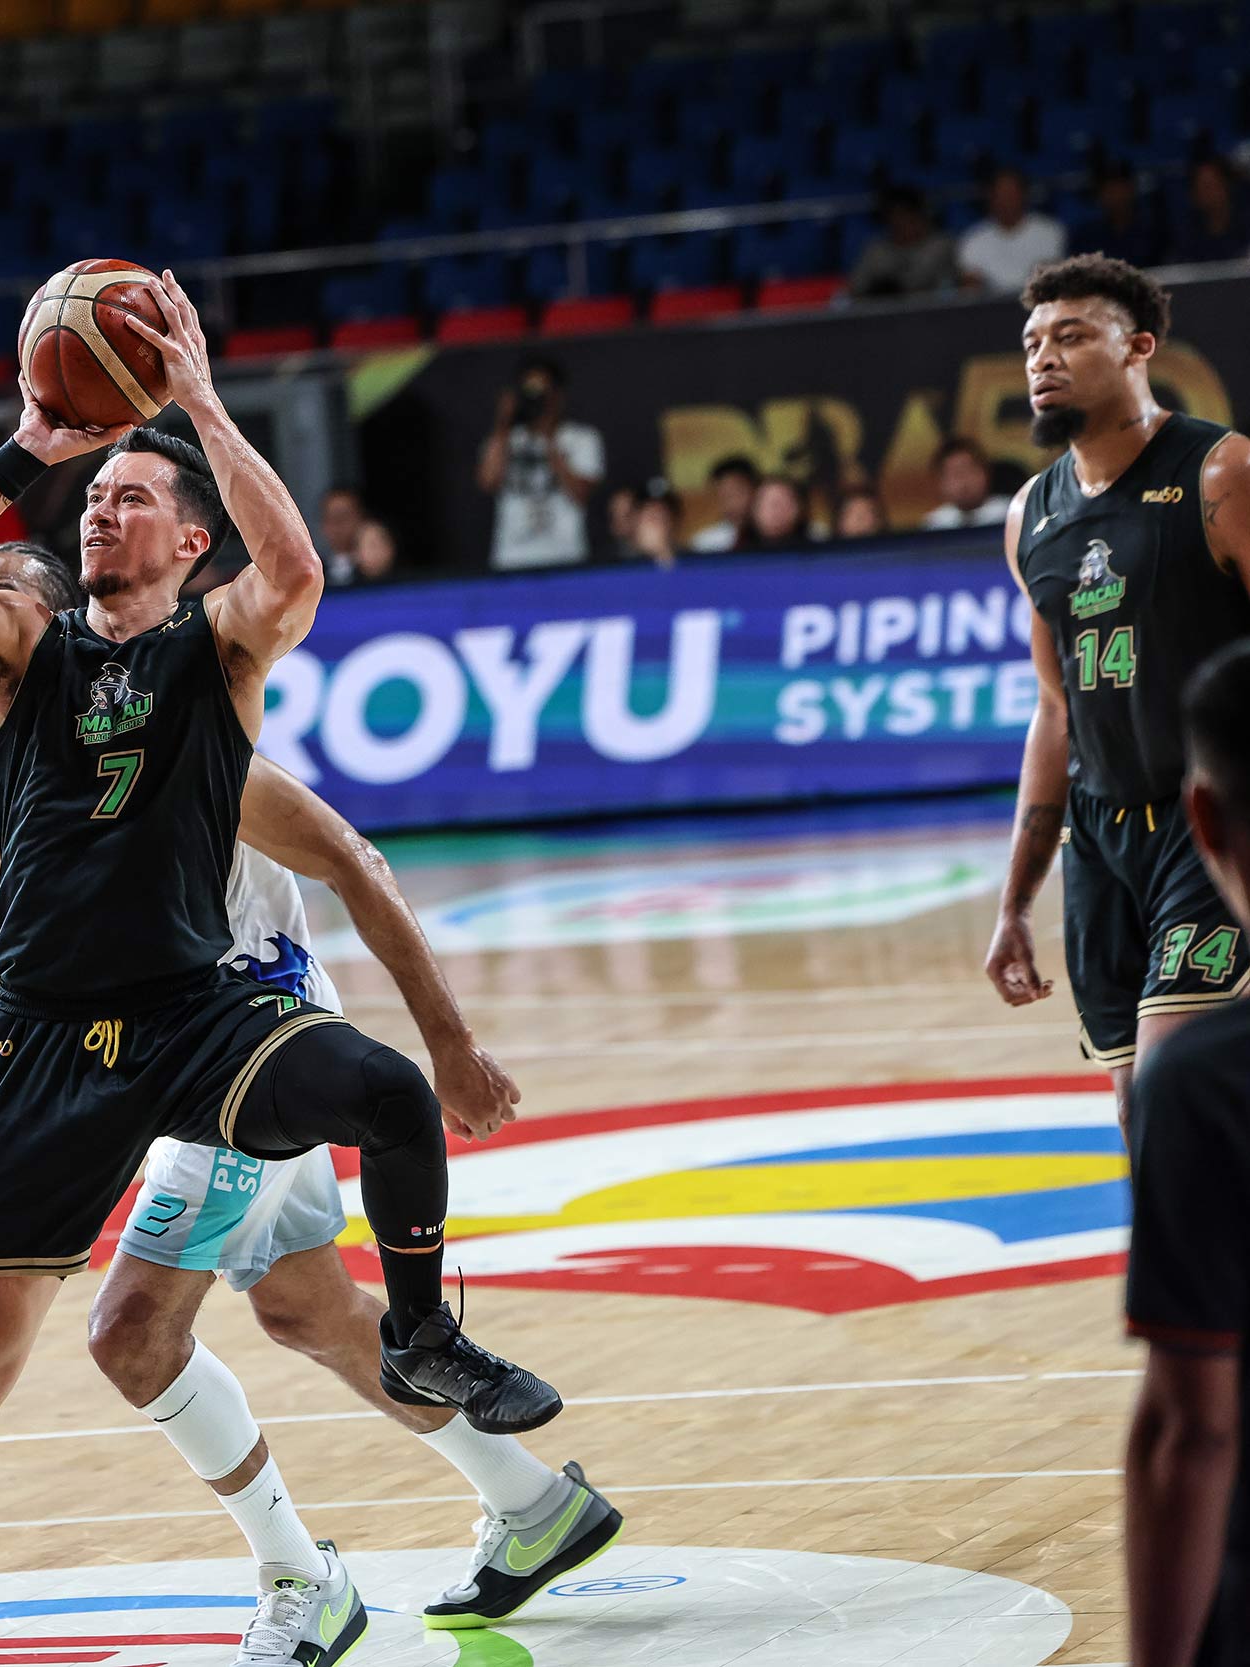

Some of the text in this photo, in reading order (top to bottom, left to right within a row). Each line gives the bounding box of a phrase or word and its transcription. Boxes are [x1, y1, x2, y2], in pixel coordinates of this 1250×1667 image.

[1073, 580, 1124, 610] MACAU
[1075, 626, 1136, 690] 14
[79, 696, 150, 735] MAAU
[254, 608, 721, 787] ROYU
[114, 716, 145, 734] NIGHTS
[91, 749, 144, 820] 7
[1158, 924, 1241, 984] 14
[134, 1193, 187, 1238] 2
